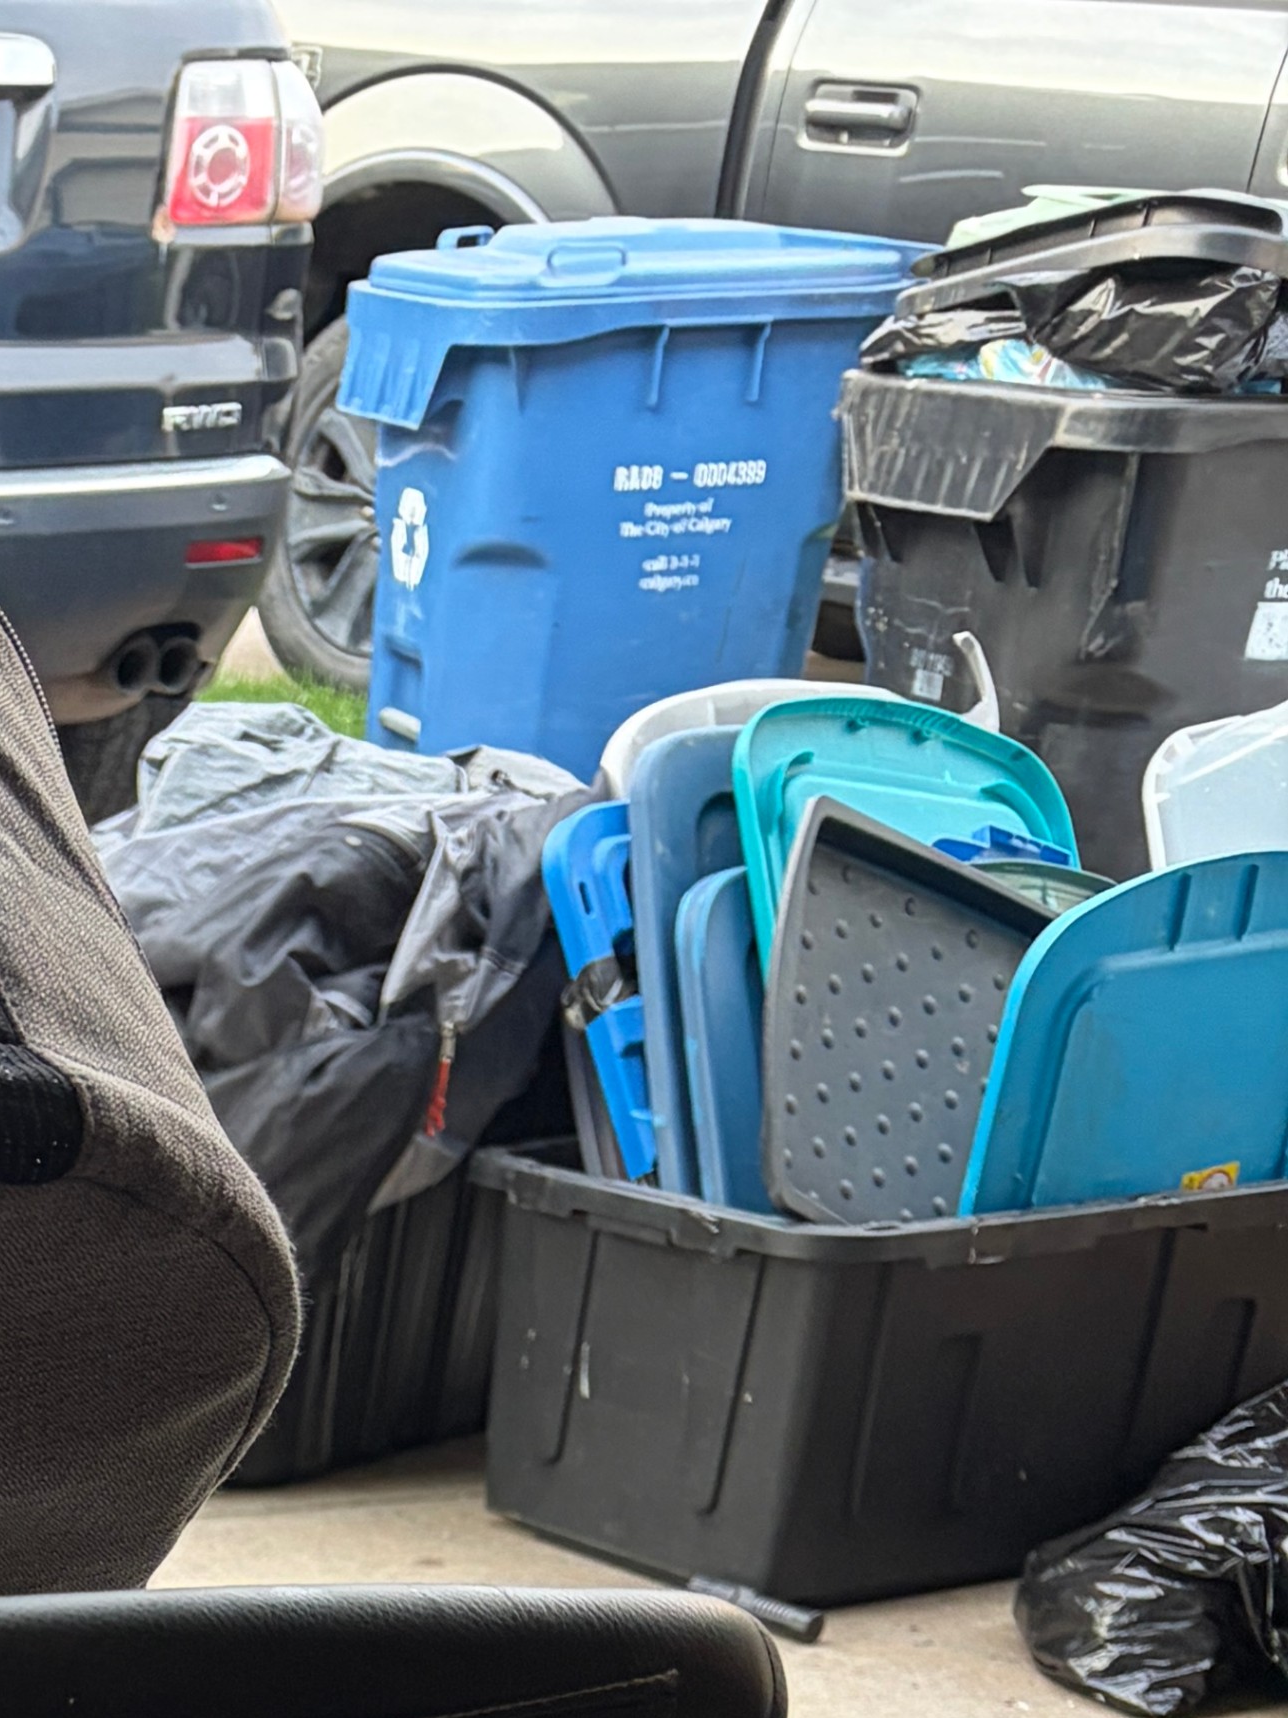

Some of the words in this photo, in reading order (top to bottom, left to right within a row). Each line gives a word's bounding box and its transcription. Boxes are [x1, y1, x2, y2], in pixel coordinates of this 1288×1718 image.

[644, 501, 696, 519] Property
[698, 497, 714, 513] of
[620, 521, 643, 537] The
[644, 520, 670, 538] City
[671, 517, 687, 534] of
[687, 516, 732, 535] Calgary
